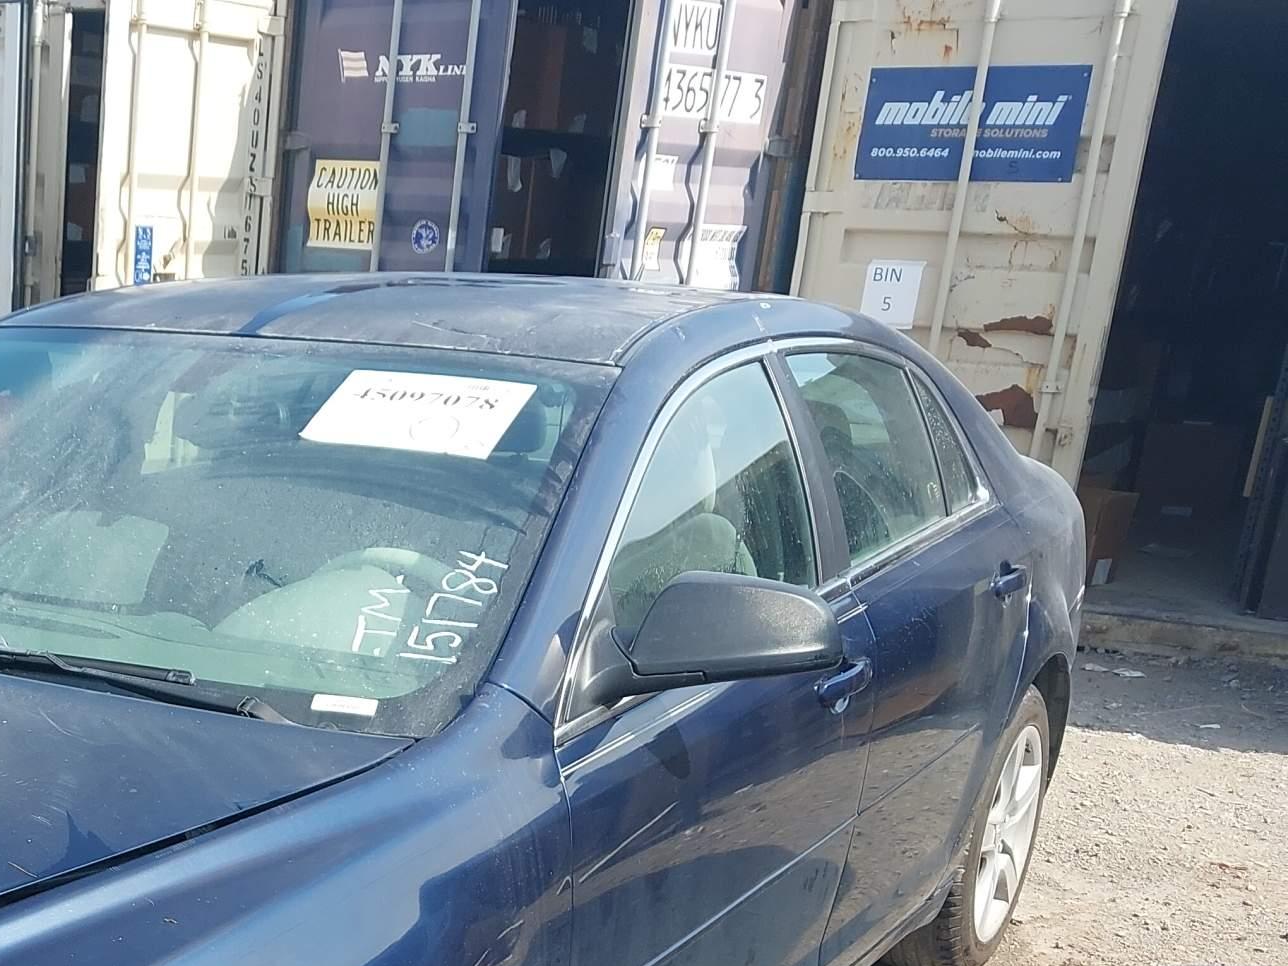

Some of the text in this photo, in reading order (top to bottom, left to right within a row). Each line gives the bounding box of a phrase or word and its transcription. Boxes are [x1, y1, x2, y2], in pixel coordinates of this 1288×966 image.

[375, 54, 441, 76] NYK
[750, 78, 765, 119] 3
[986, 95, 1068, 125] mini
[930, 127, 1049, 138] STORAE SOLUTIONS
[870, 147, 950, 158] 800.950.6464
[315, 166, 379, 191] CAUTION
[326, 193, 361, 217] HIGH
[314, 218, 375, 244] TRAILER
[872, 266, 903, 282] BIN
[880, 296, 892, 311] 5
[353, 386, 499, 410] 45097078
[395, 550, 510, 664] 151784
